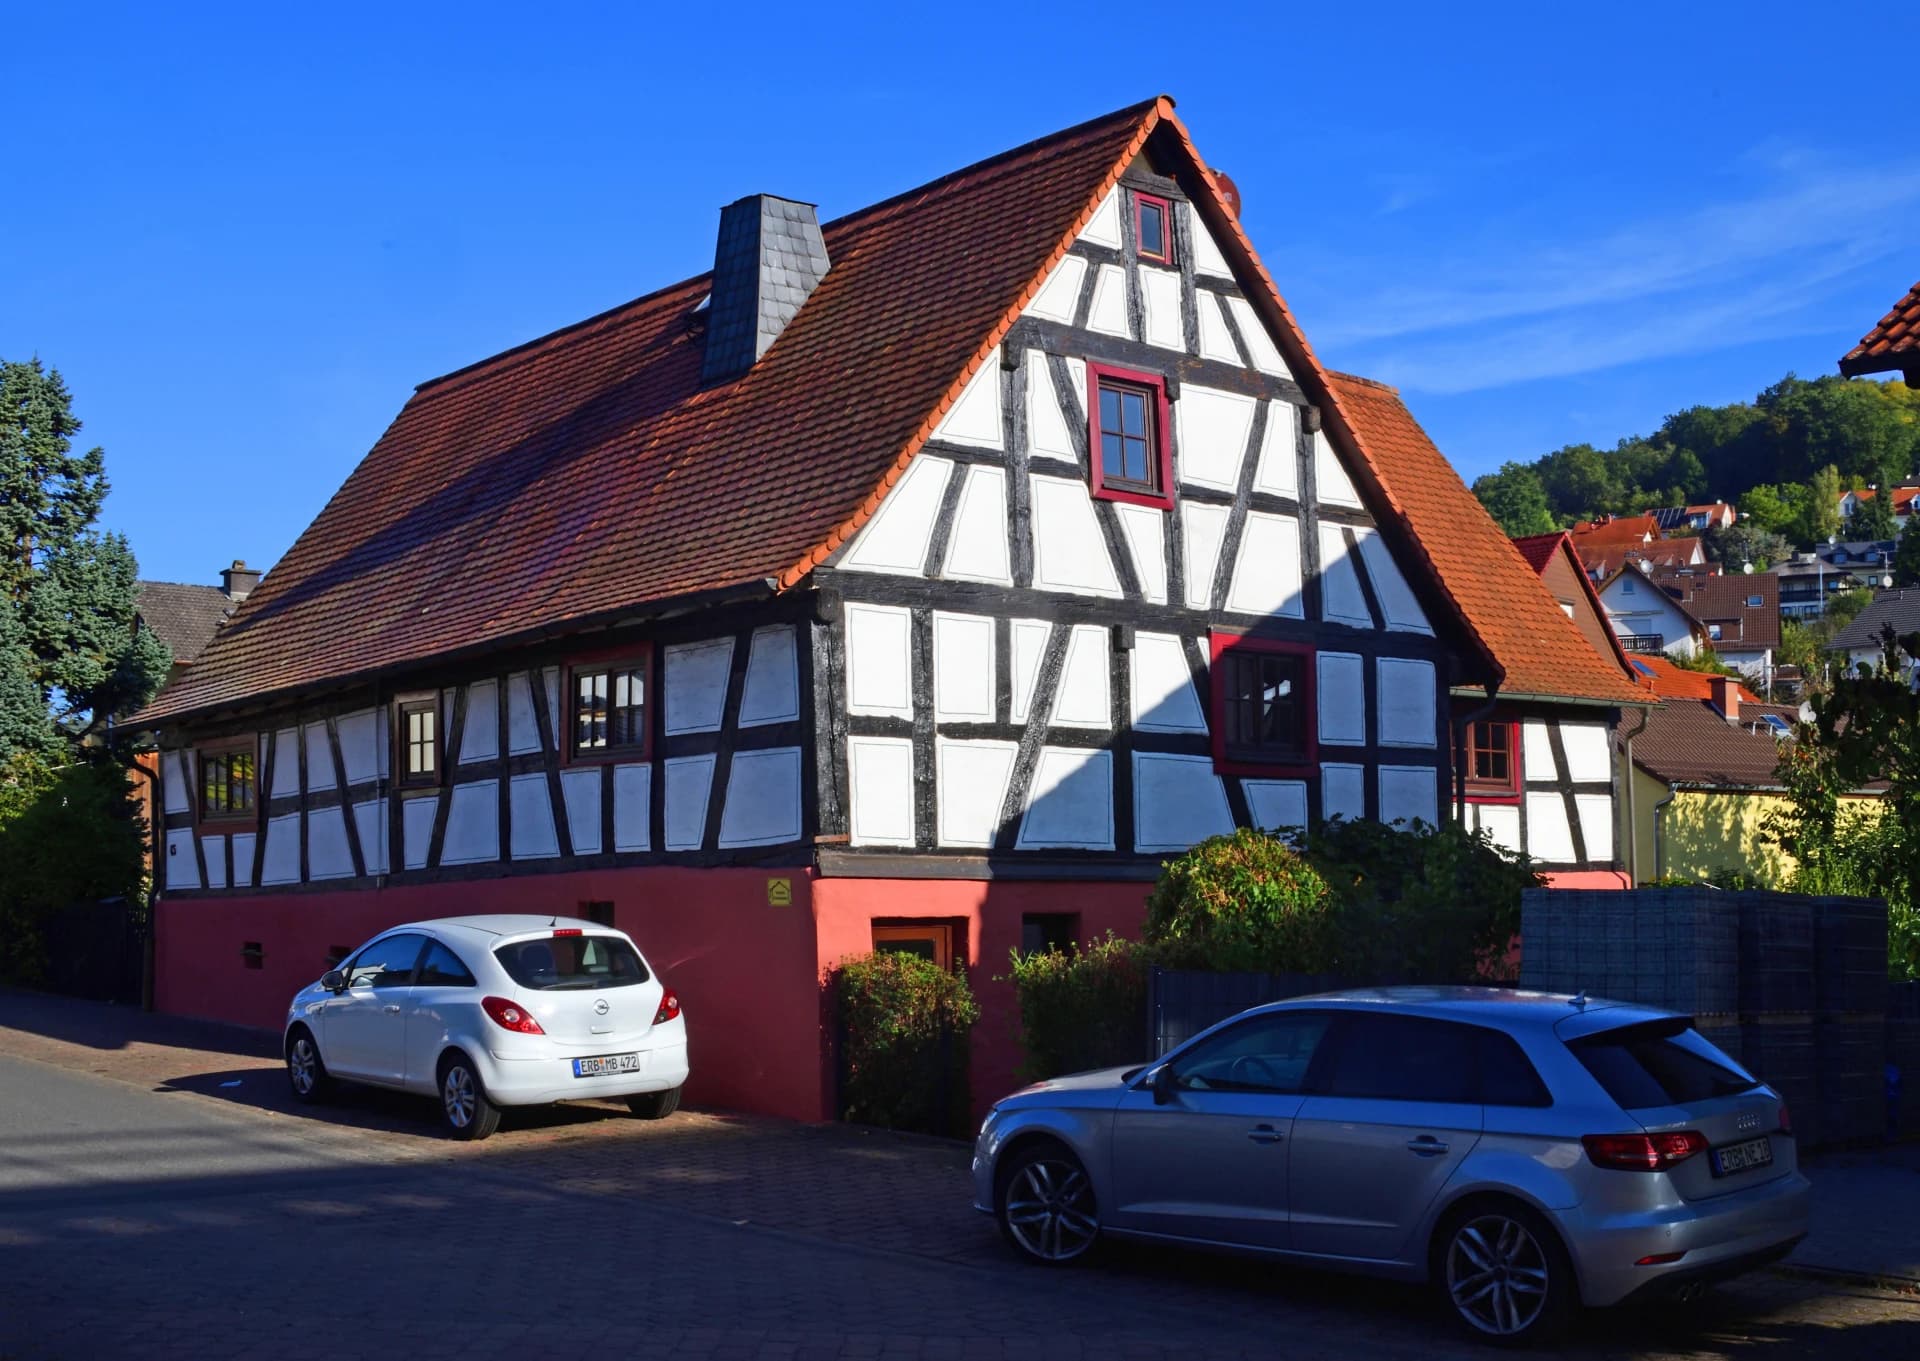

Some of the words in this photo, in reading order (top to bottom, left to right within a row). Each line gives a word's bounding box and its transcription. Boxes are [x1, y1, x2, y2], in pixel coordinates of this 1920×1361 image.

[581, 1060, 600, 1073] ERB
[605, 1058, 618, 1070] MB
[620, 1056, 637, 1069] 472
